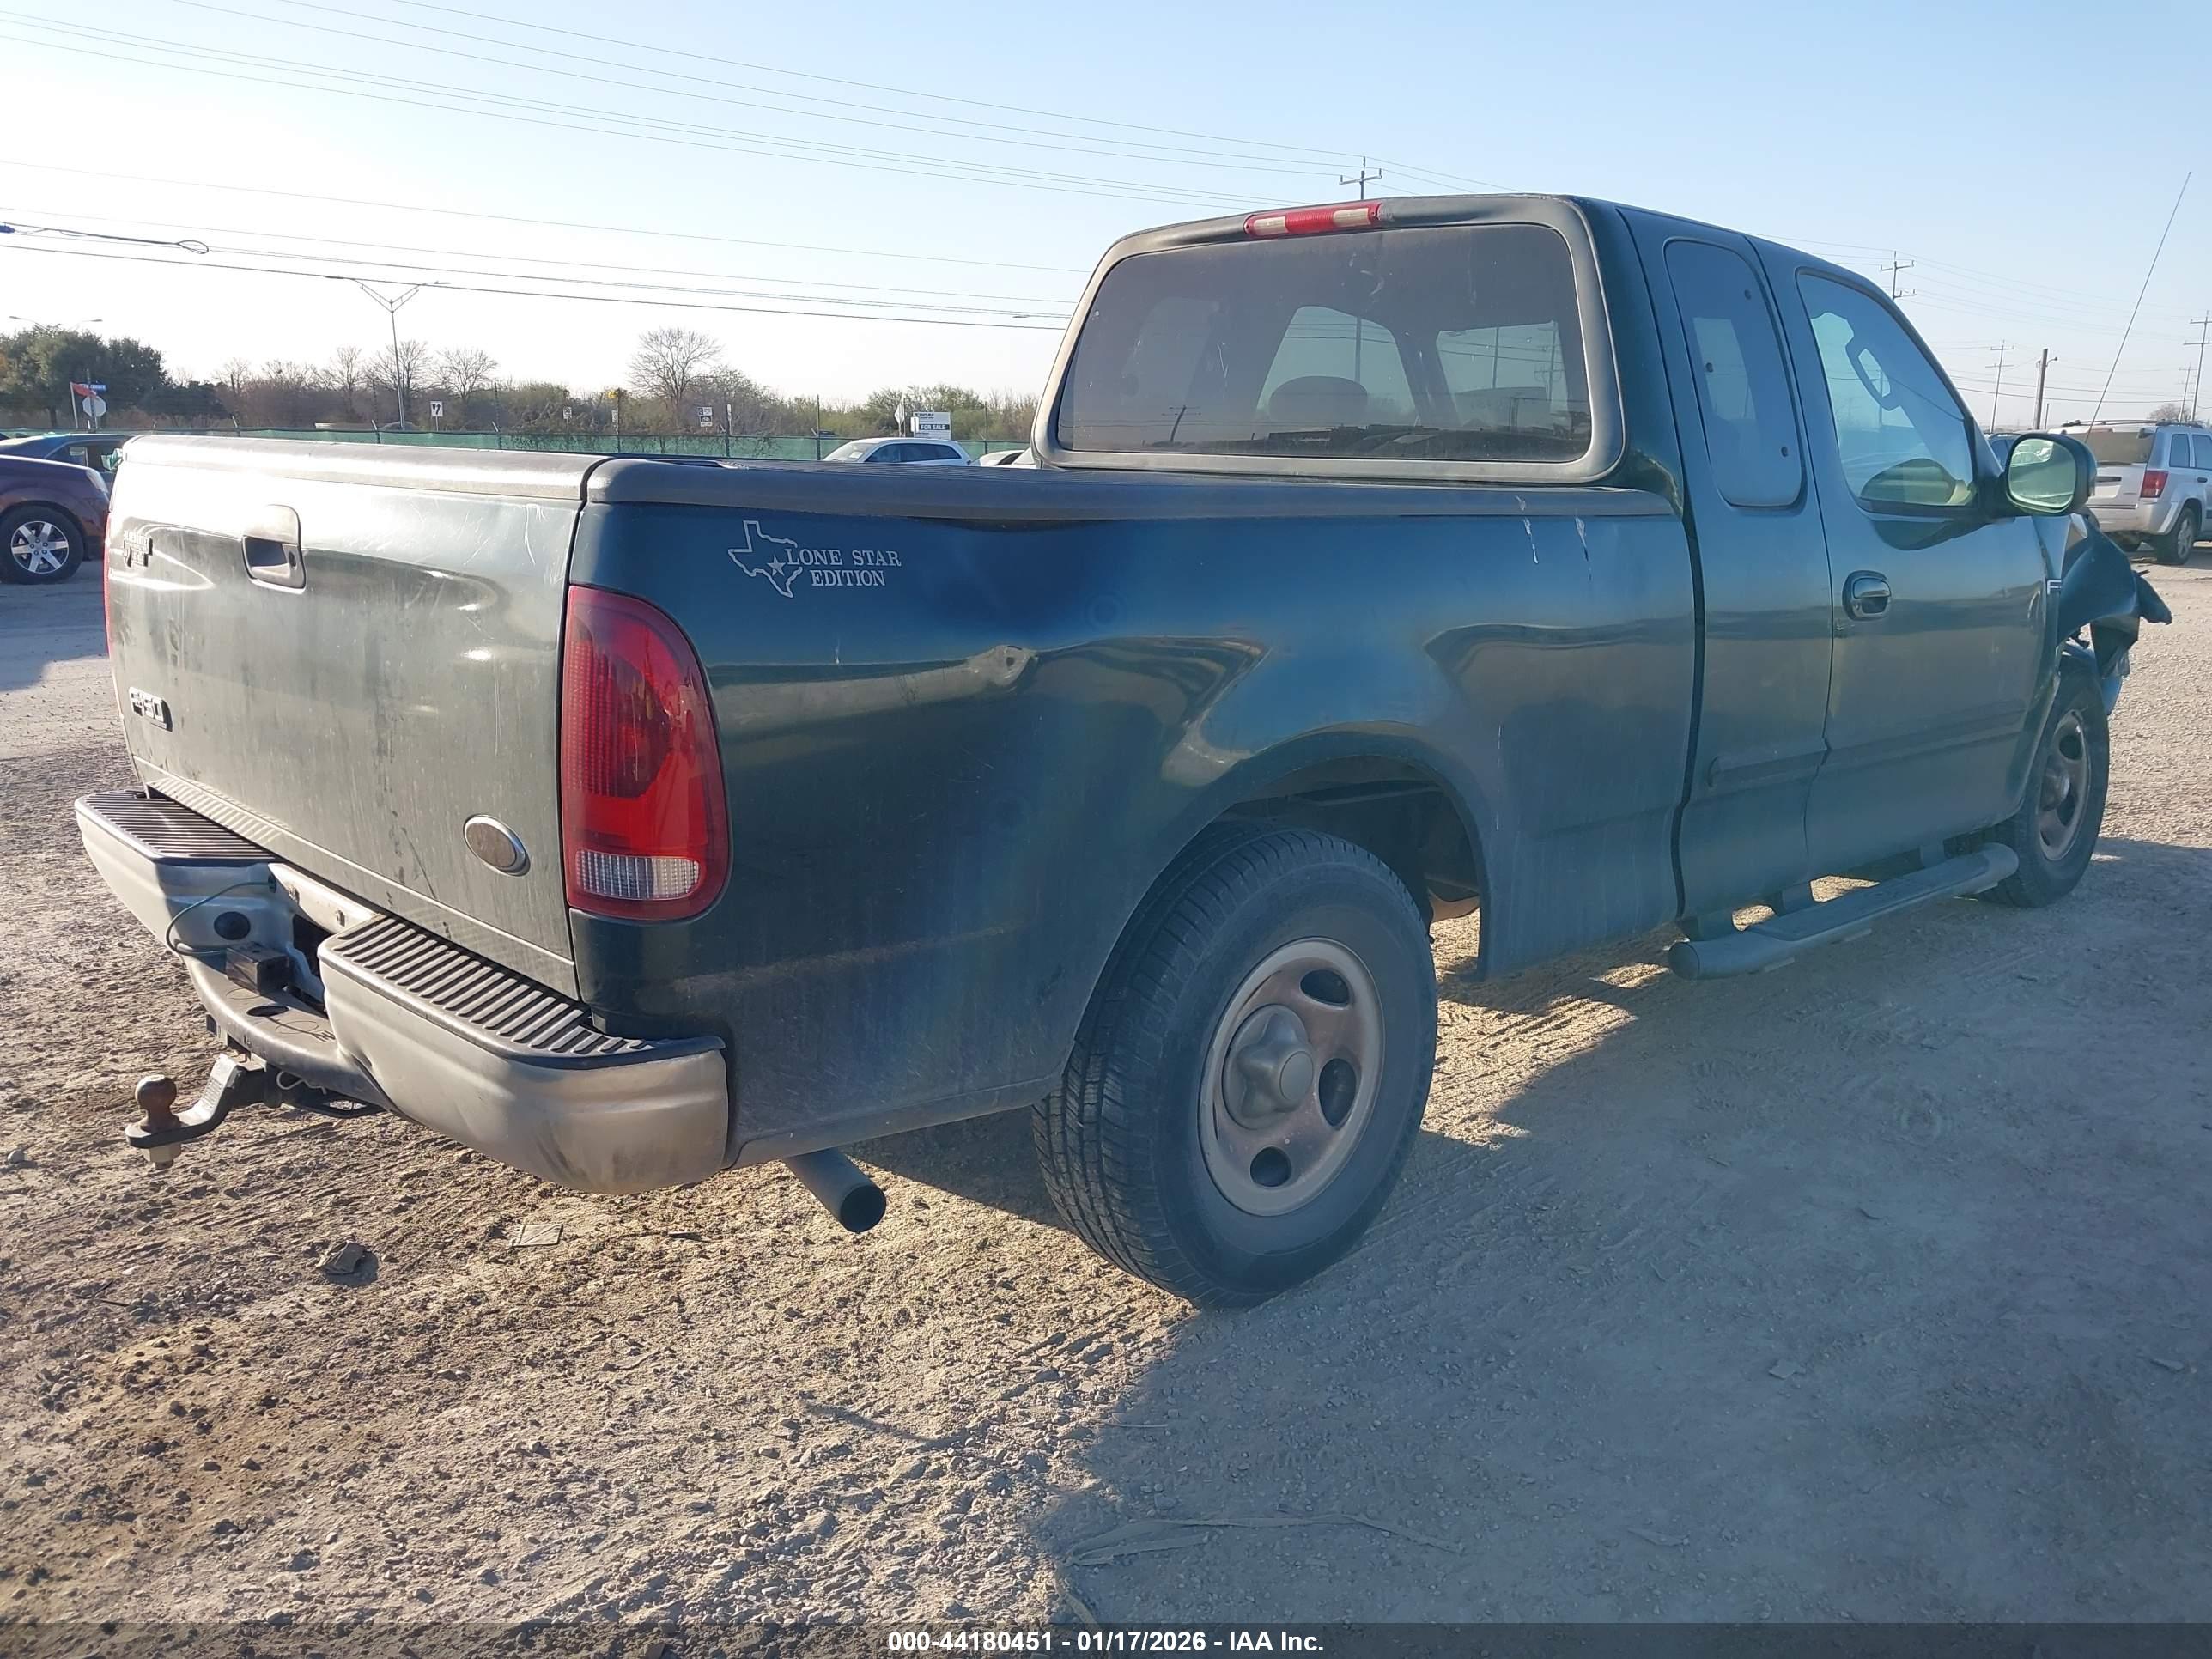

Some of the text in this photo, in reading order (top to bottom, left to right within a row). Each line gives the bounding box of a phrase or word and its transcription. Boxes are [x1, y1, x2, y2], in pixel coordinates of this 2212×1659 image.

[784, 548, 902, 567] LONE STAR
[809, 569, 886, 586] EDITION
